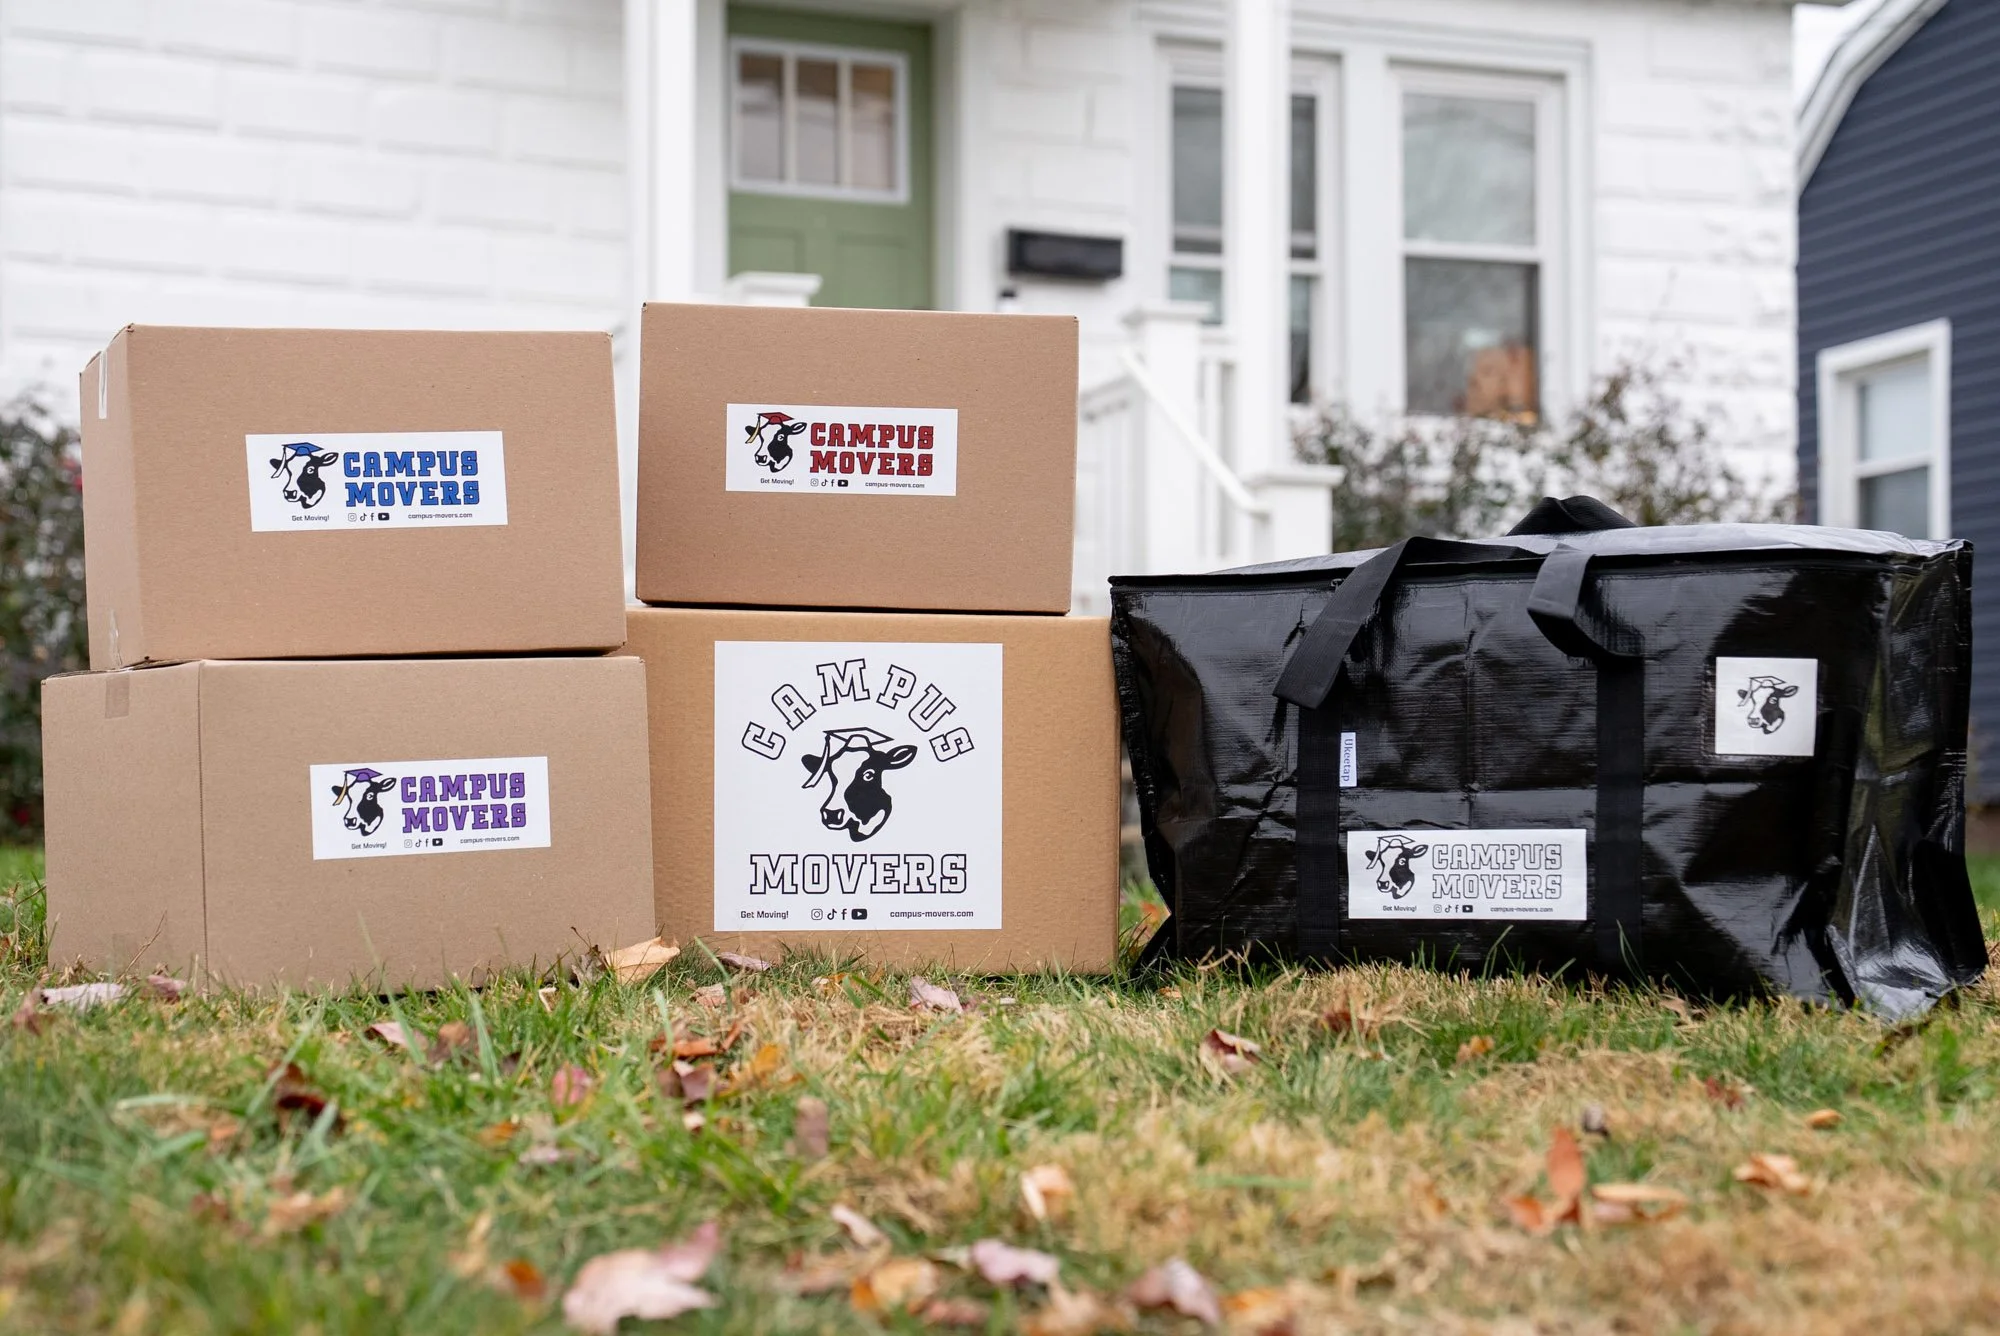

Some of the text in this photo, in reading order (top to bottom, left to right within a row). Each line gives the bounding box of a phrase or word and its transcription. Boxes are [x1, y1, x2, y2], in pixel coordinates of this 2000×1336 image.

[809, 422, 934, 449] CAMPUS
[343, 451, 479, 477] CAMPUS
[810, 450, 933, 476] MOVERS
[345, 480, 480, 507] MOVERS
[760, 477, 794, 486] Get Moving!
[291, 513, 330, 522] Get Moving!
[408, 511, 473, 520] campus-movers.com
[741, 658, 975, 762] CAMPUS
[400, 772, 526, 803] CAMPUS
[402, 803, 527, 833] MOVERS
[351, 842, 387, 850] Get Moving!
[460, 835, 520, 844] campus-movers.com
[1432, 844, 1562, 870] CAMPUS
[750, 853, 967, 894] MOVERS
[1432, 874, 1562, 899] MOVERS
[740, 909, 789, 920] Get Moving!
[889, 909, 974, 920] campus-movers.com
[1394, 904, 1417, 912] Moving!
[1490, 905, 1553, 913] campus-movers.com
